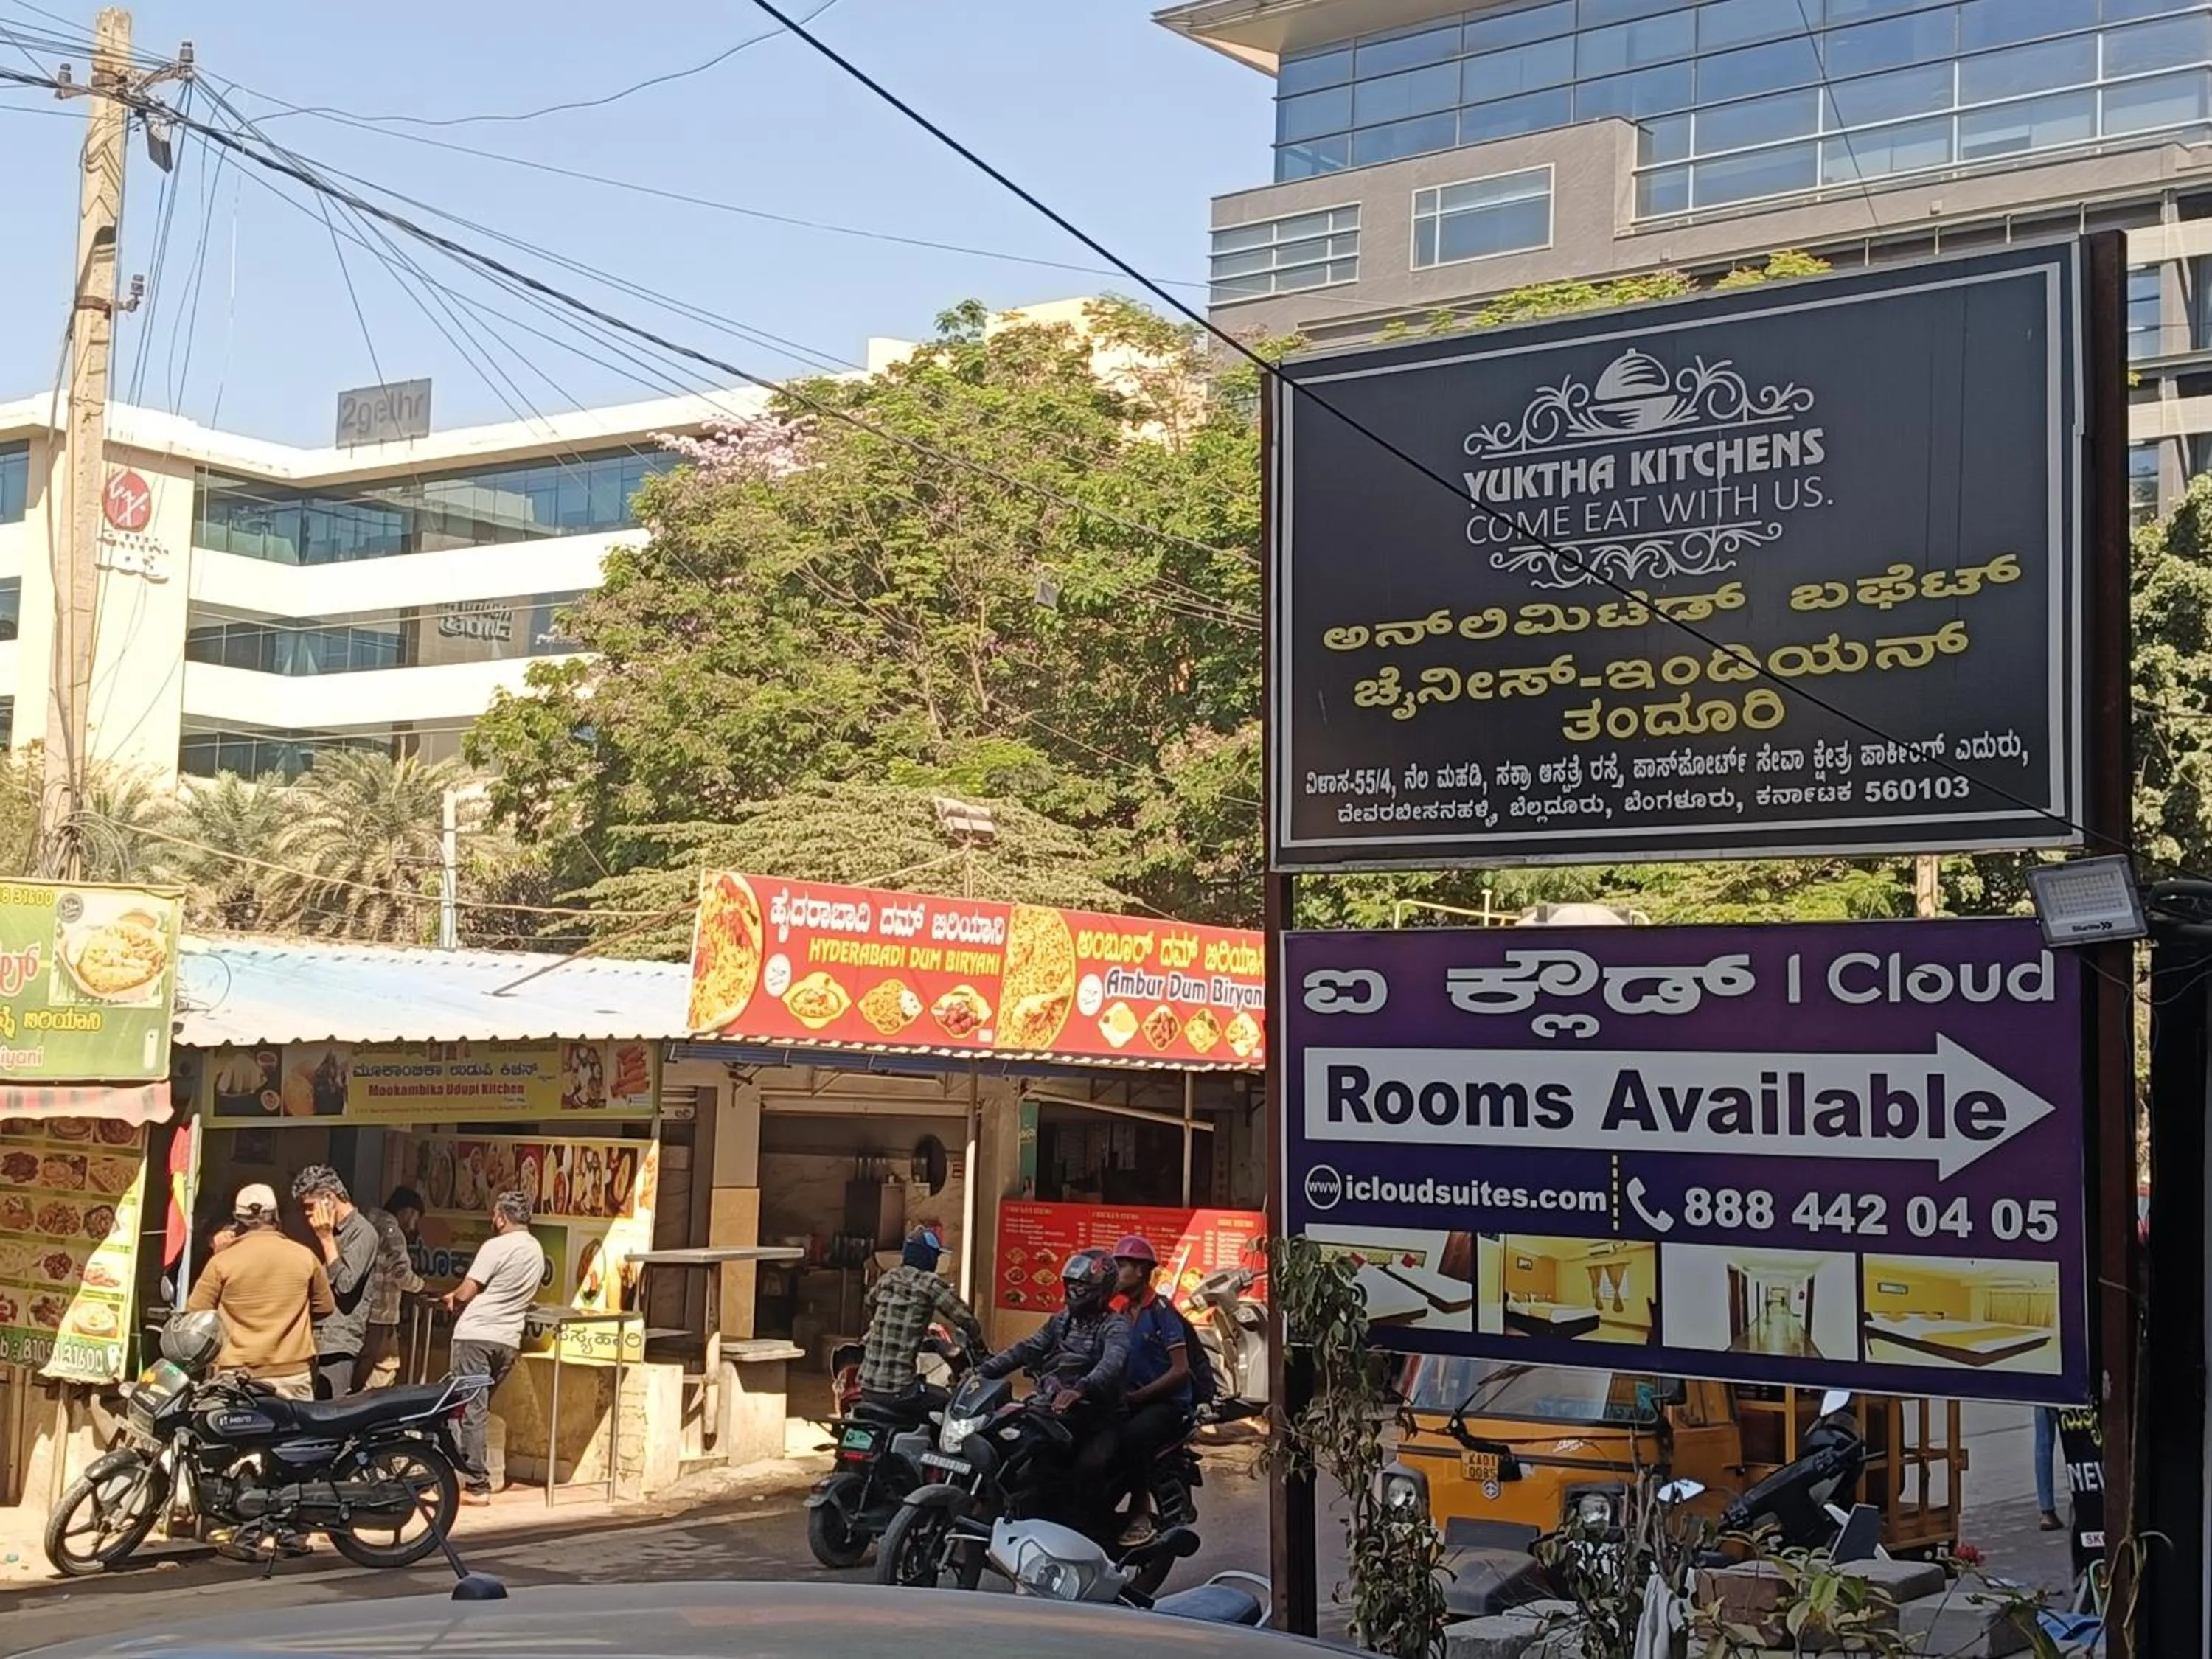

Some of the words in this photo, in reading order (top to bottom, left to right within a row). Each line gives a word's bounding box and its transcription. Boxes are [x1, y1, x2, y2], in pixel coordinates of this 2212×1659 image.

[1463, 454, 1616, 509] YUKTHA
[1630, 427, 1826, 487] KITCHENS
[1466, 505, 1571, 546] COME
[1585, 496, 1648, 533] EAT
[1658, 483, 1758, 525] WITH
[1775, 476, 1834, 512] US.
[1562, 688, 1786, 741] ತಂದೂರಿ
[1404, 762, 1430, 790] ನೆಲ
[1756, 742, 1805, 773] ಸೇವಾ
[1756, 780, 1852, 805] ಕರ್ನಾಟಕ
[1865, 776, 1970, 803] 560103
[880, 900, 925, 937] ದಮ್
[808, 937, 905, 969] HYDERABADI
[909, 947, 943, 970] DUM
[945, 949, 1002, 976] BIRYANI
[1106, 968, 1164, 997] Ambur
[1169, 973, 1206, 1001] Dum
[1212, 978, 1263, 1009] Biryan
[1303, 969, 1388, 1014] ಐ
[1827, 949, 2056, 1004] Cloud
[368, 1082, 443, 1097] Mookambika
[445, 1082, 480, 1098] Udupi
[481, 1082, 524, 1096] Kitchen
[1326, 1065, 1574, 1130] Rooms
[1601, 1069, 2008, 1140] Available
[1346, 1175, 1607, 1211] icloudsuites.com
[1684, 1187, 1775, 1229] 888
[1792, 1192, 1888, 1235] 442
[1906, 1196, 1972, 1238] 04
[1991, 1198, 2058, 1242] 05
